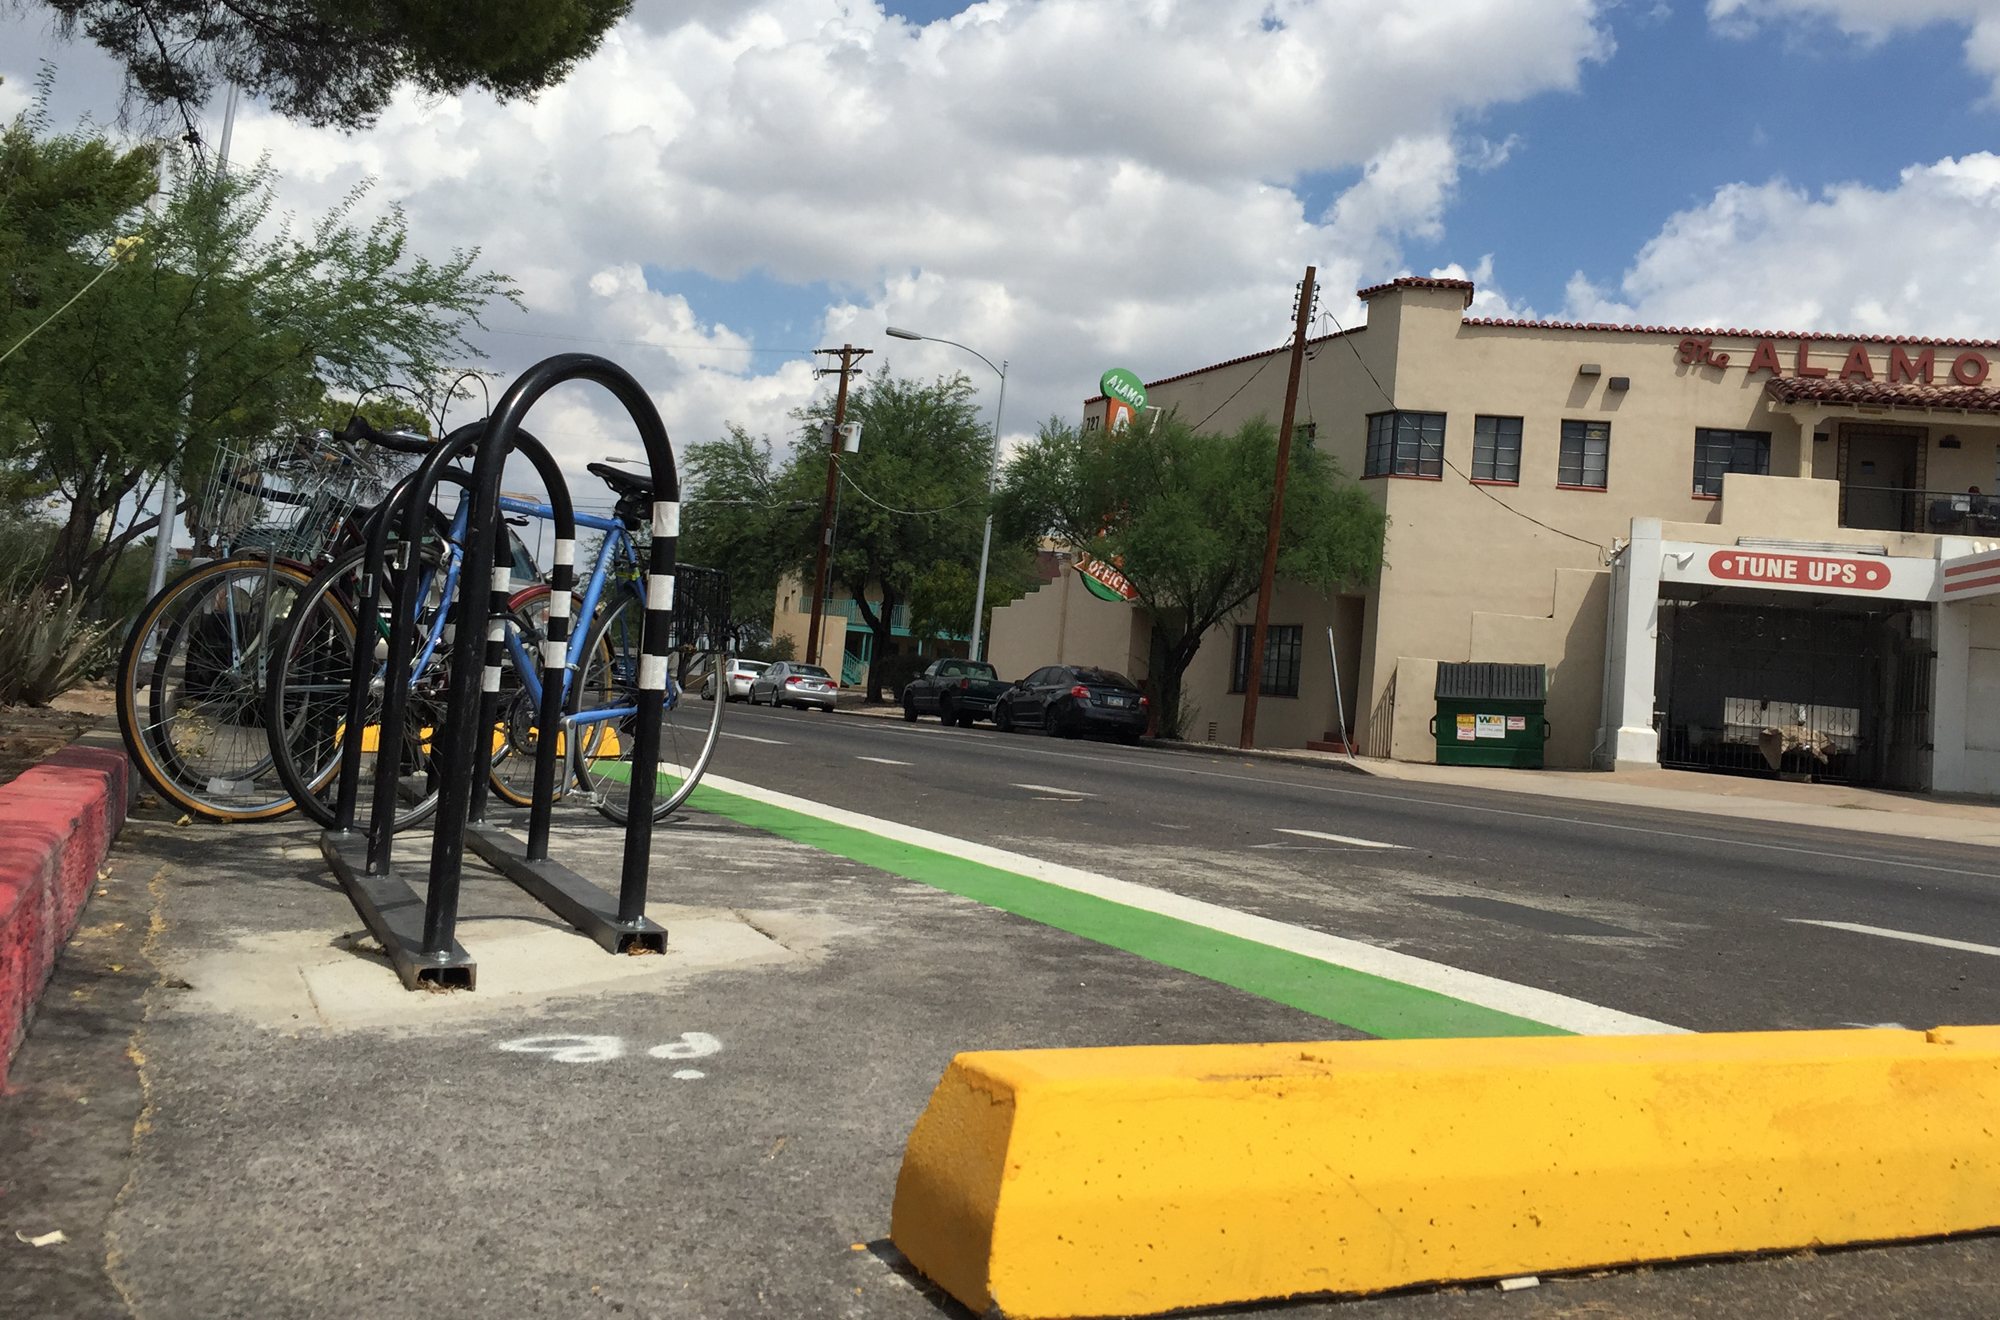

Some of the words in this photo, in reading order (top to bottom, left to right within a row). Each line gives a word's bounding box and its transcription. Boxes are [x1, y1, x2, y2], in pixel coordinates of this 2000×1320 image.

[1678, 338, 1731, 369] The
[1748, 341, 1990, 385] ALAMO
[1106, 374, 1145, 408] ALAMO
[1086, 415, 1100, 431] 727
[1088, 560, 1129, 594] OFFICE
[1735, 556, 1798, 580] TUNE
[1808, 562, 1857, 584] UPS
